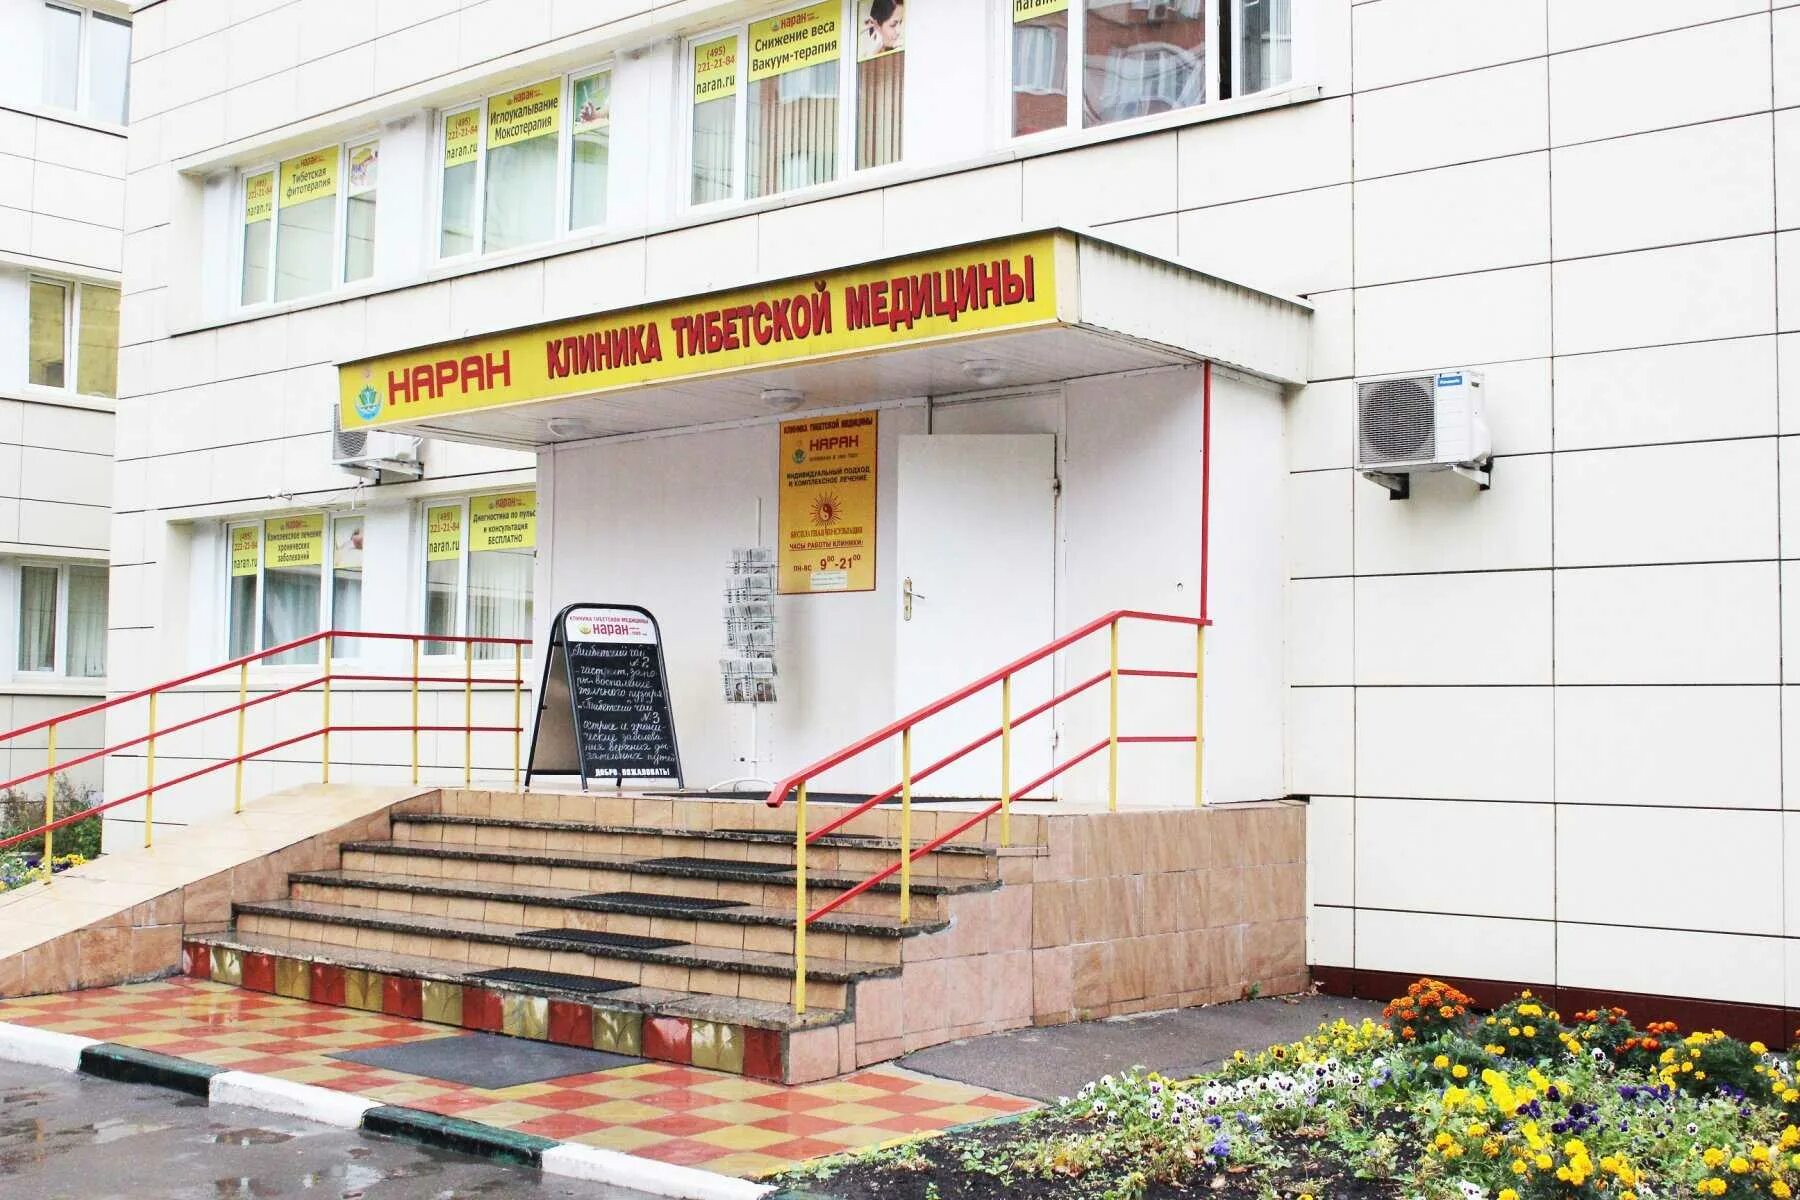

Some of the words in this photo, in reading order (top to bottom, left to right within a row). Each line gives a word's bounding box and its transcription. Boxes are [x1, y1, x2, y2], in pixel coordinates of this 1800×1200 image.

[1016, 0, 1058, 12] nara.
[781, 12, 808, 28] наран
[755, 28, 809, 52] Снижение
[811, 20, 835, 37] веса
[706, 45, 726, 60] (495)
[752, 40, 837, 72] Вакуум-терапия
[697, 55, 736, 73] 221-21-84
[696, 74, 735, 95] naran.ru
[490, 97, 558, 126] Иглоукалывание
[494, 115, 552, 141] Моксотерапия
[447, 143, 478, 160] naran.ru
[292, 168, 327, 184] Тибетская
[286, 177, 331, 199] фитотерапия
[388, 349, 512, 406] НАРАН
[546, 323, 663, 380] КЛИНИКА
[671, 280, 833, 358] ТИБЕТСКОЙ
[845, 254, 1035, 332] МЕДИЦИНЫ
[809, 435, 859, 451] НАРАН
[473, 513, 509, 523] Диагностика
[519, 510, 536, 520] пульс
[488, 523, 528, 534] консультация
[429, 540, 460, 553] naran.ru
[488, 534, 523, 545] БЕСПЛАТНО
[592, 623, 629, 636] наран
